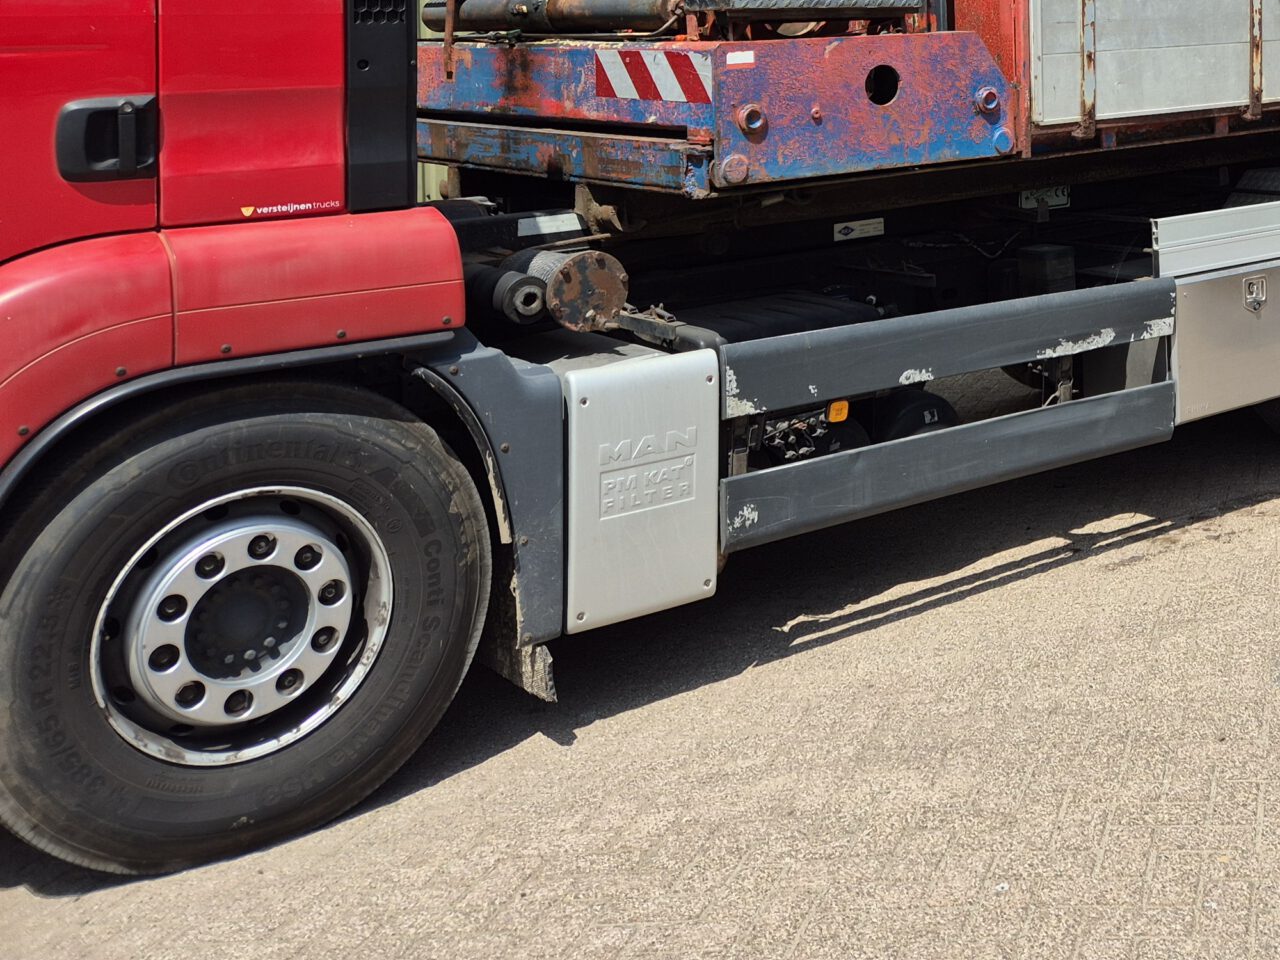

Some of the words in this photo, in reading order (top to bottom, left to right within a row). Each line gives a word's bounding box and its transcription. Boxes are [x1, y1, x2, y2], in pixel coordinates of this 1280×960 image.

[256, 203, 312, 213] versteijnen
[313, 200, 340, 209] trucks
[166, 441, 338, 486] Continental
[599, 426, 697, 466] MAN
[603, 475, 637, 496] PM
[603, 482, 690, 514] FILTER
[422, 539, 443, 607] Conti
